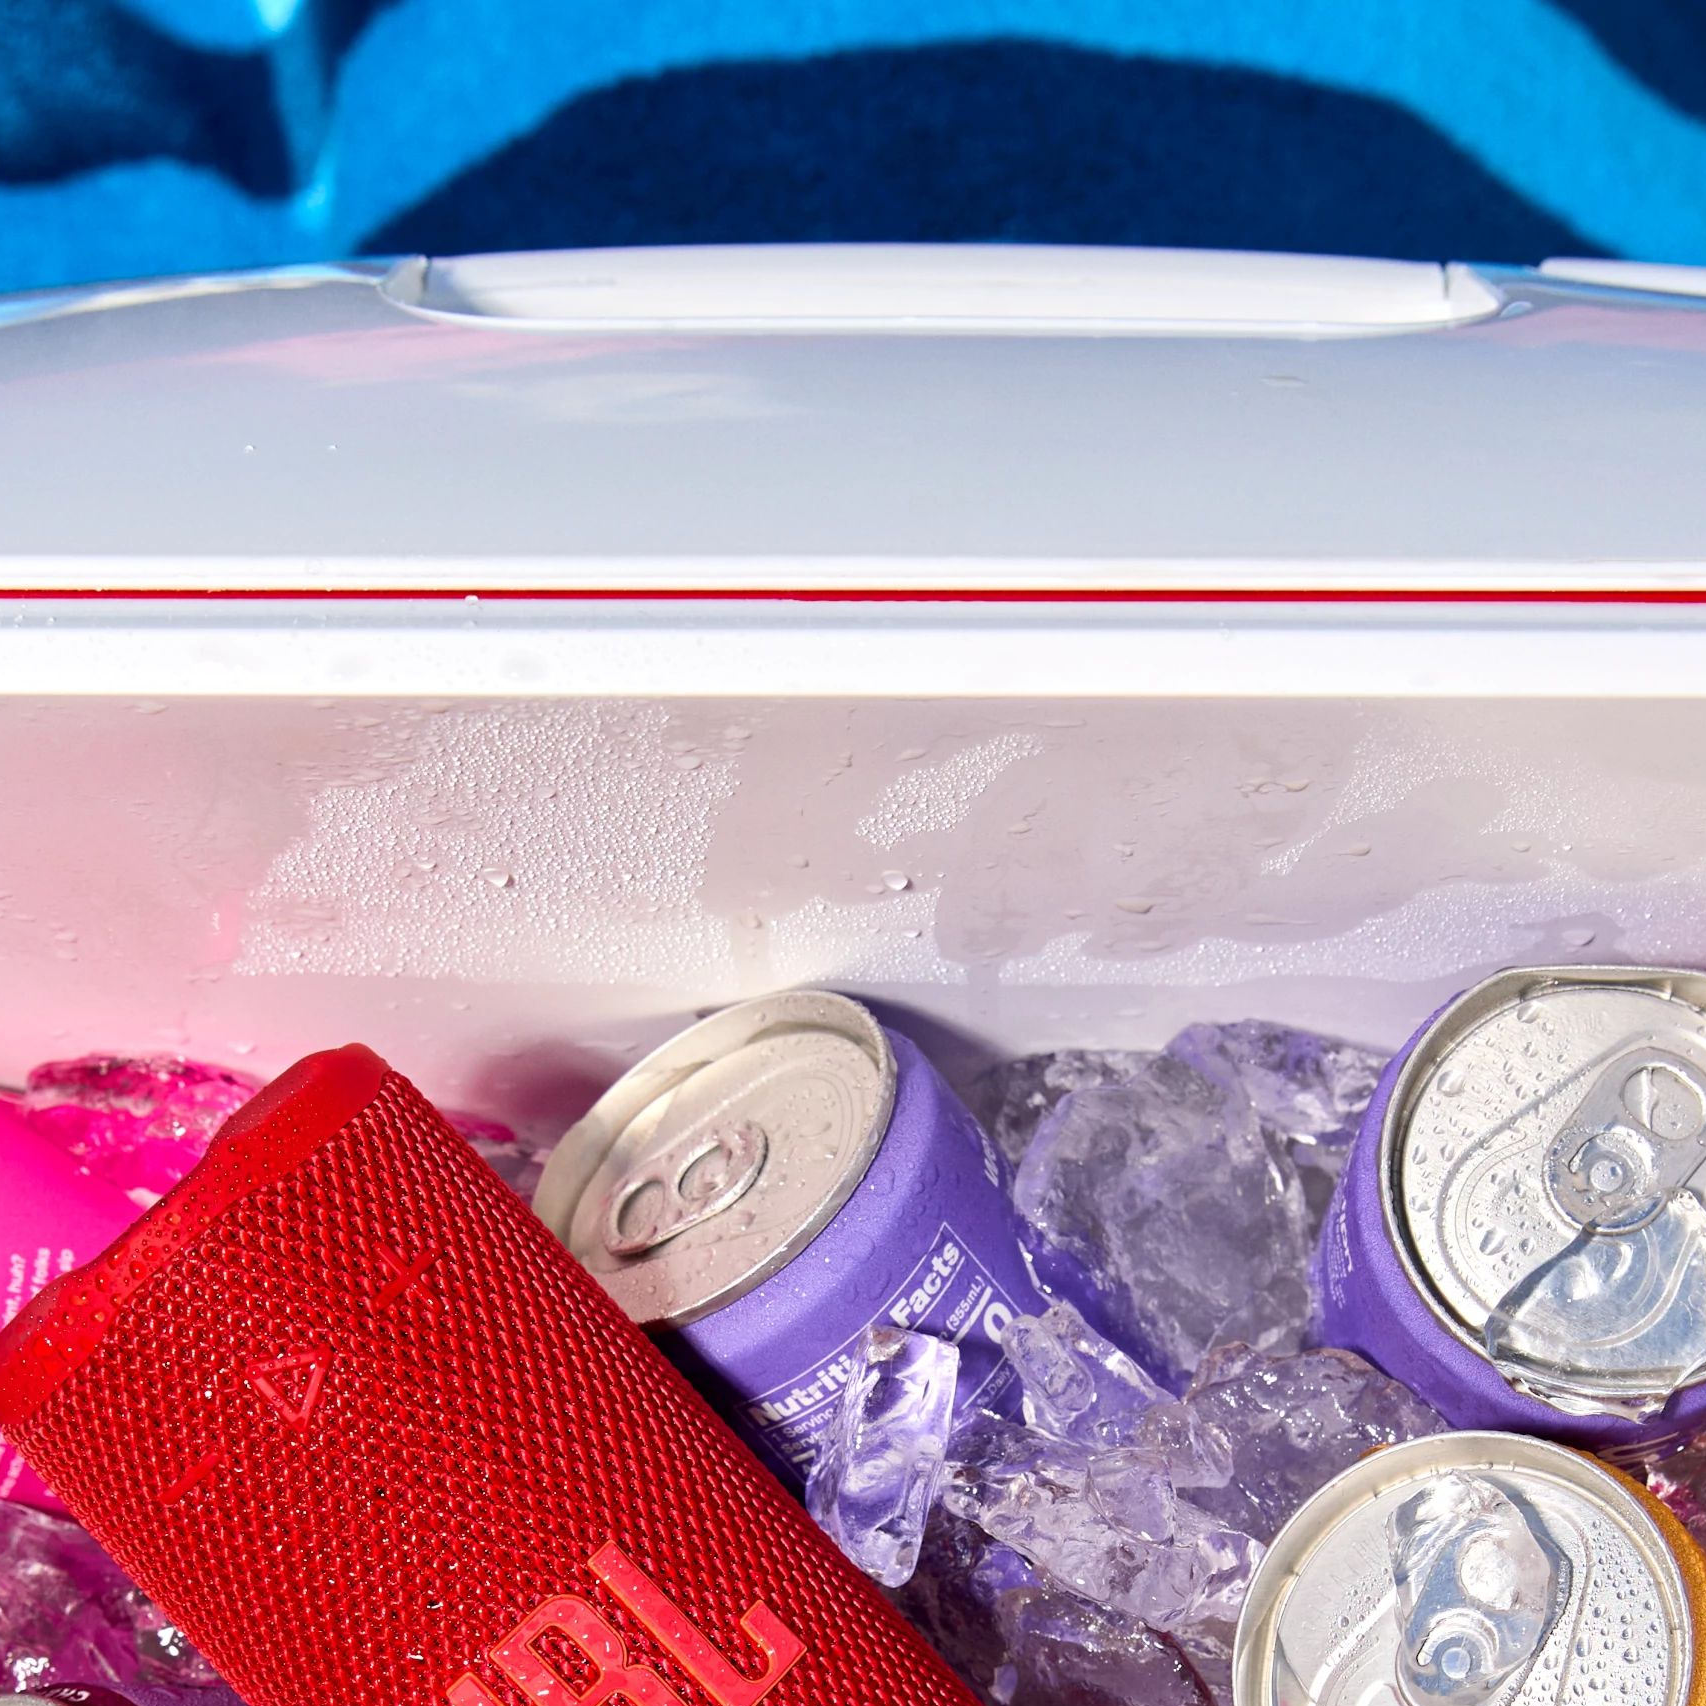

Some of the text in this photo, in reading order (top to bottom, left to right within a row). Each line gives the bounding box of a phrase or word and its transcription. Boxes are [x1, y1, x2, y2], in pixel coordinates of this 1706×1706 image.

[7, 1254, 26, 1293] huh?
[945, 1275, 987, 1332] (355mL)
[983, 1301, 1014, 1345] 0
[747, 1241, 961, 1426] Nutriti Facts
